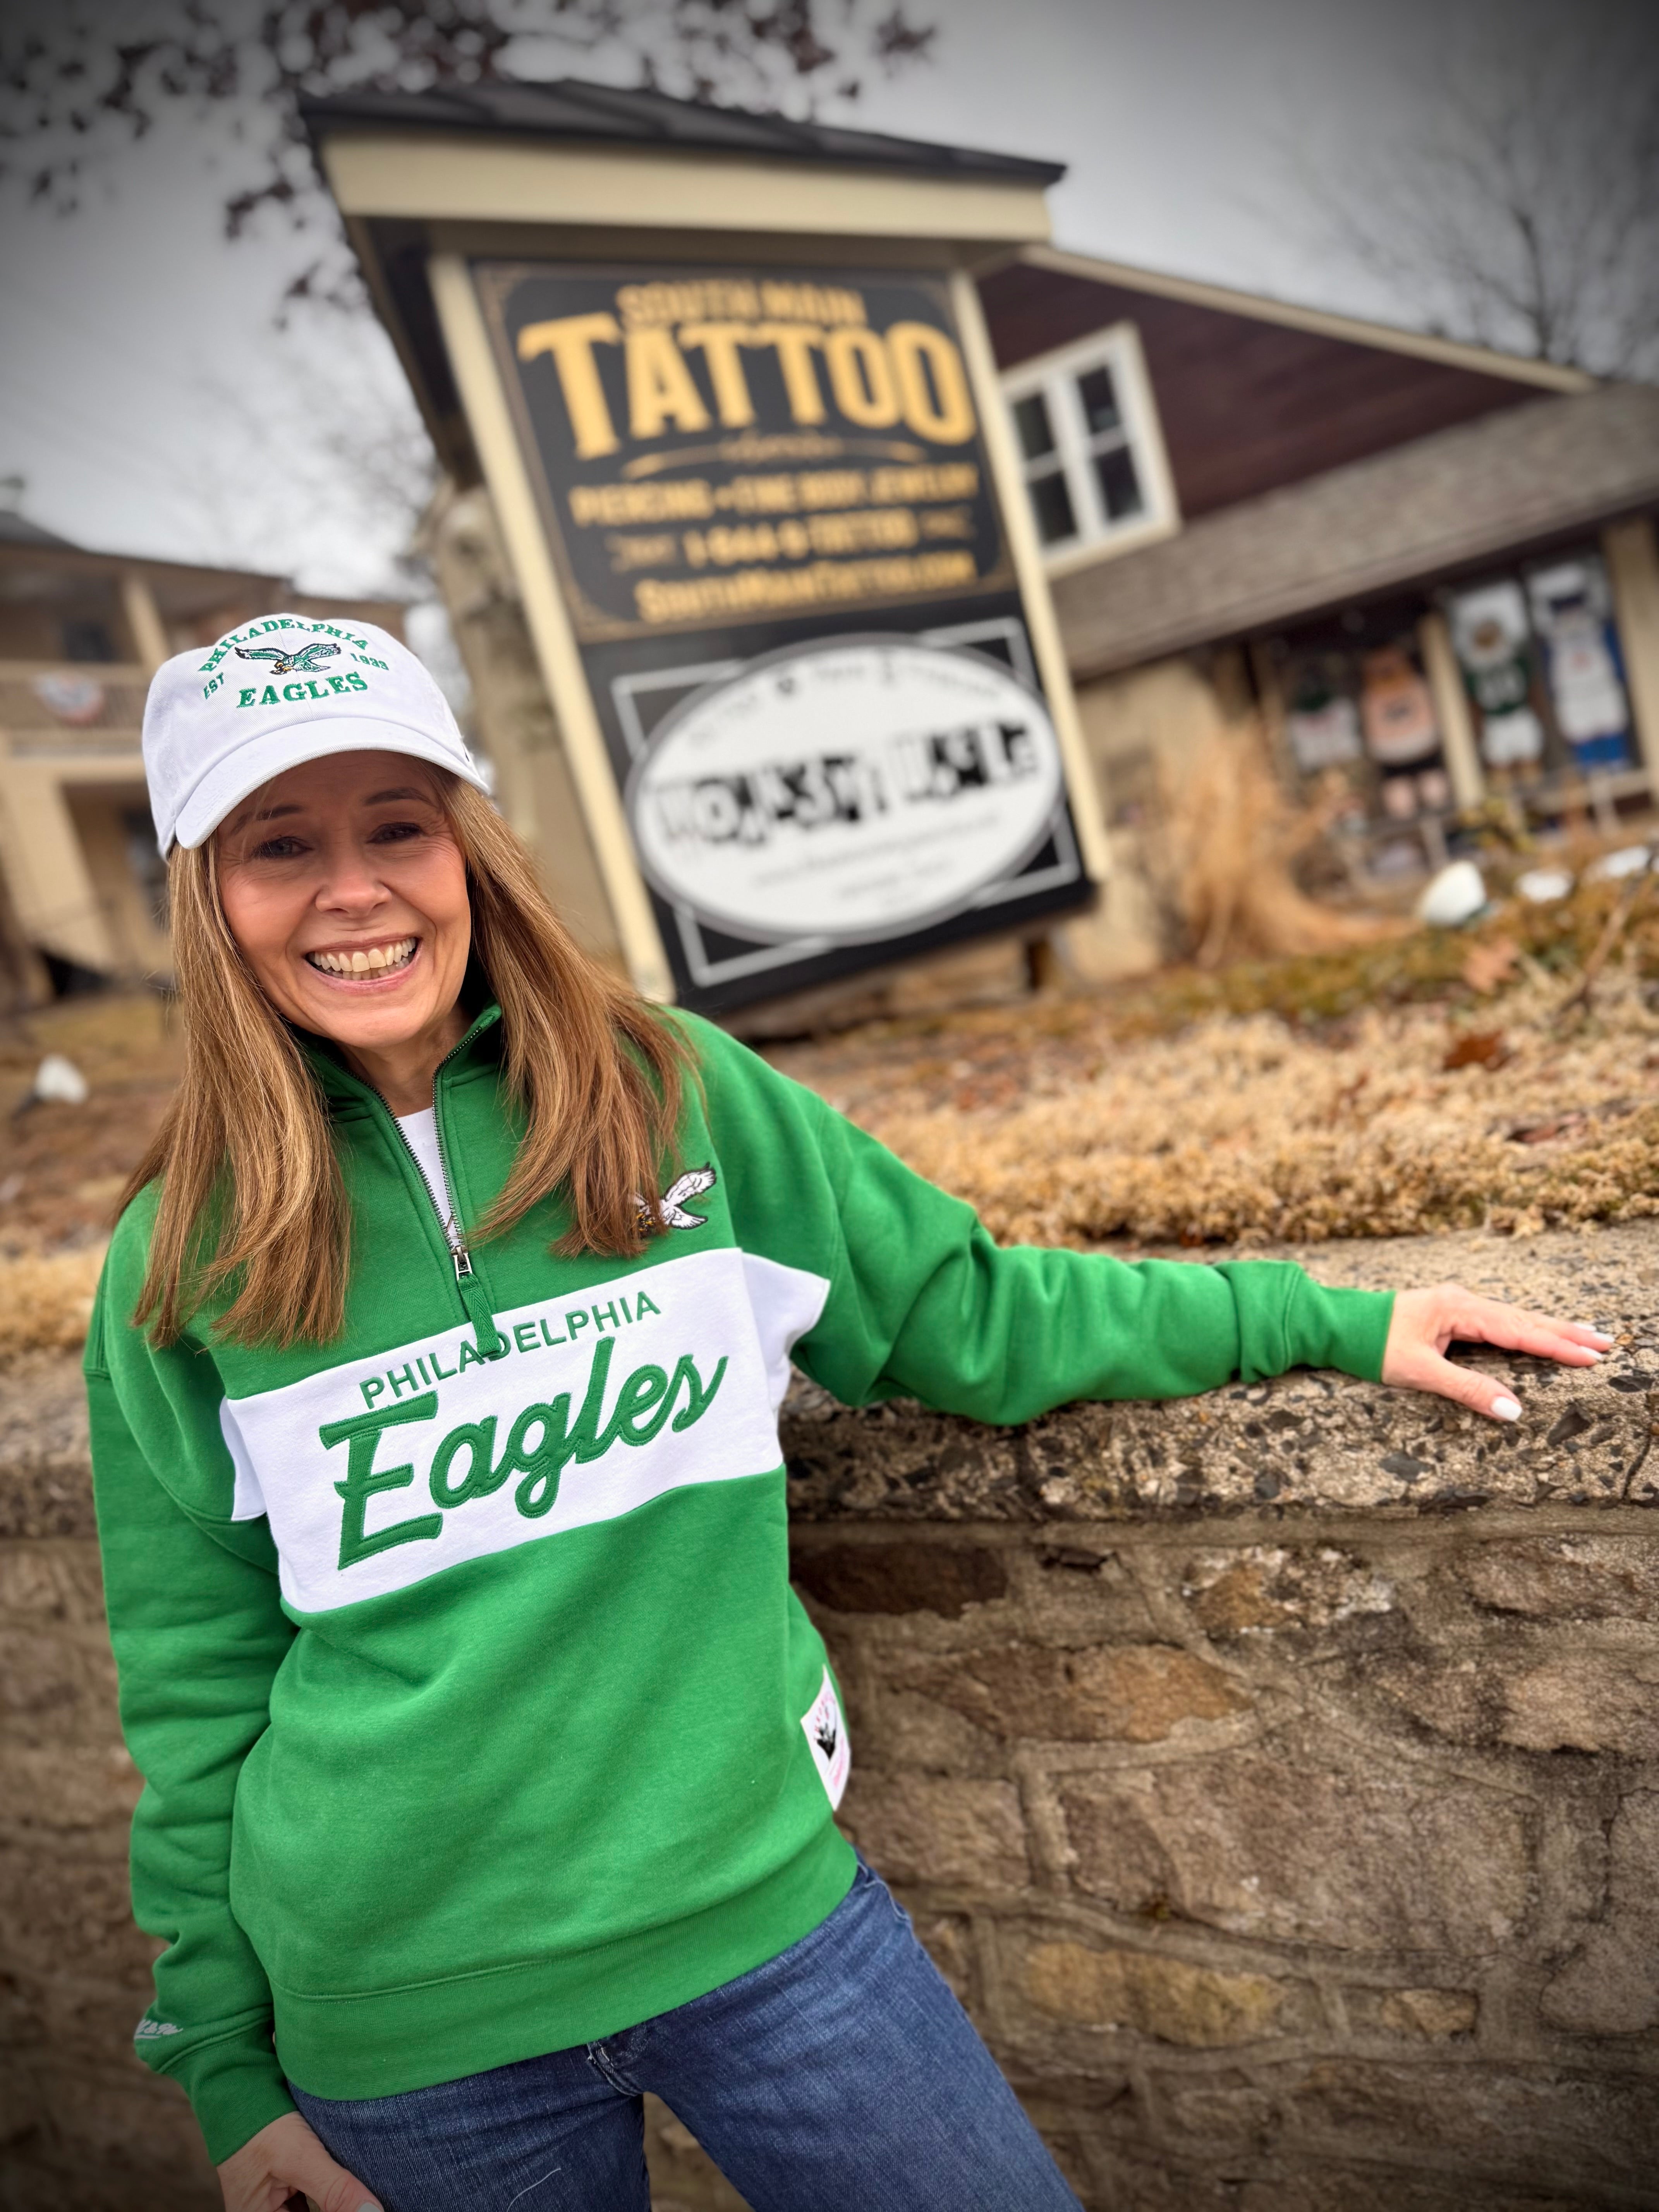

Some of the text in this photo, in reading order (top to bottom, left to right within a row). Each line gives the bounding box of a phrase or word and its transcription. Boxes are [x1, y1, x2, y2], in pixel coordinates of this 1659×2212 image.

[518, 312, 977, 460] TATTOO
[569, 479, 714, 528] PIERCING
[197, 618, 369, 672] PHILADELPHIA
[203, 672, 224, 700] EST
[236, 671, 368, 708] EAGLES
[359, 1291, 661, 1410] PHILADELPHIA
[318, 1336, 730, 1571] Eagles
